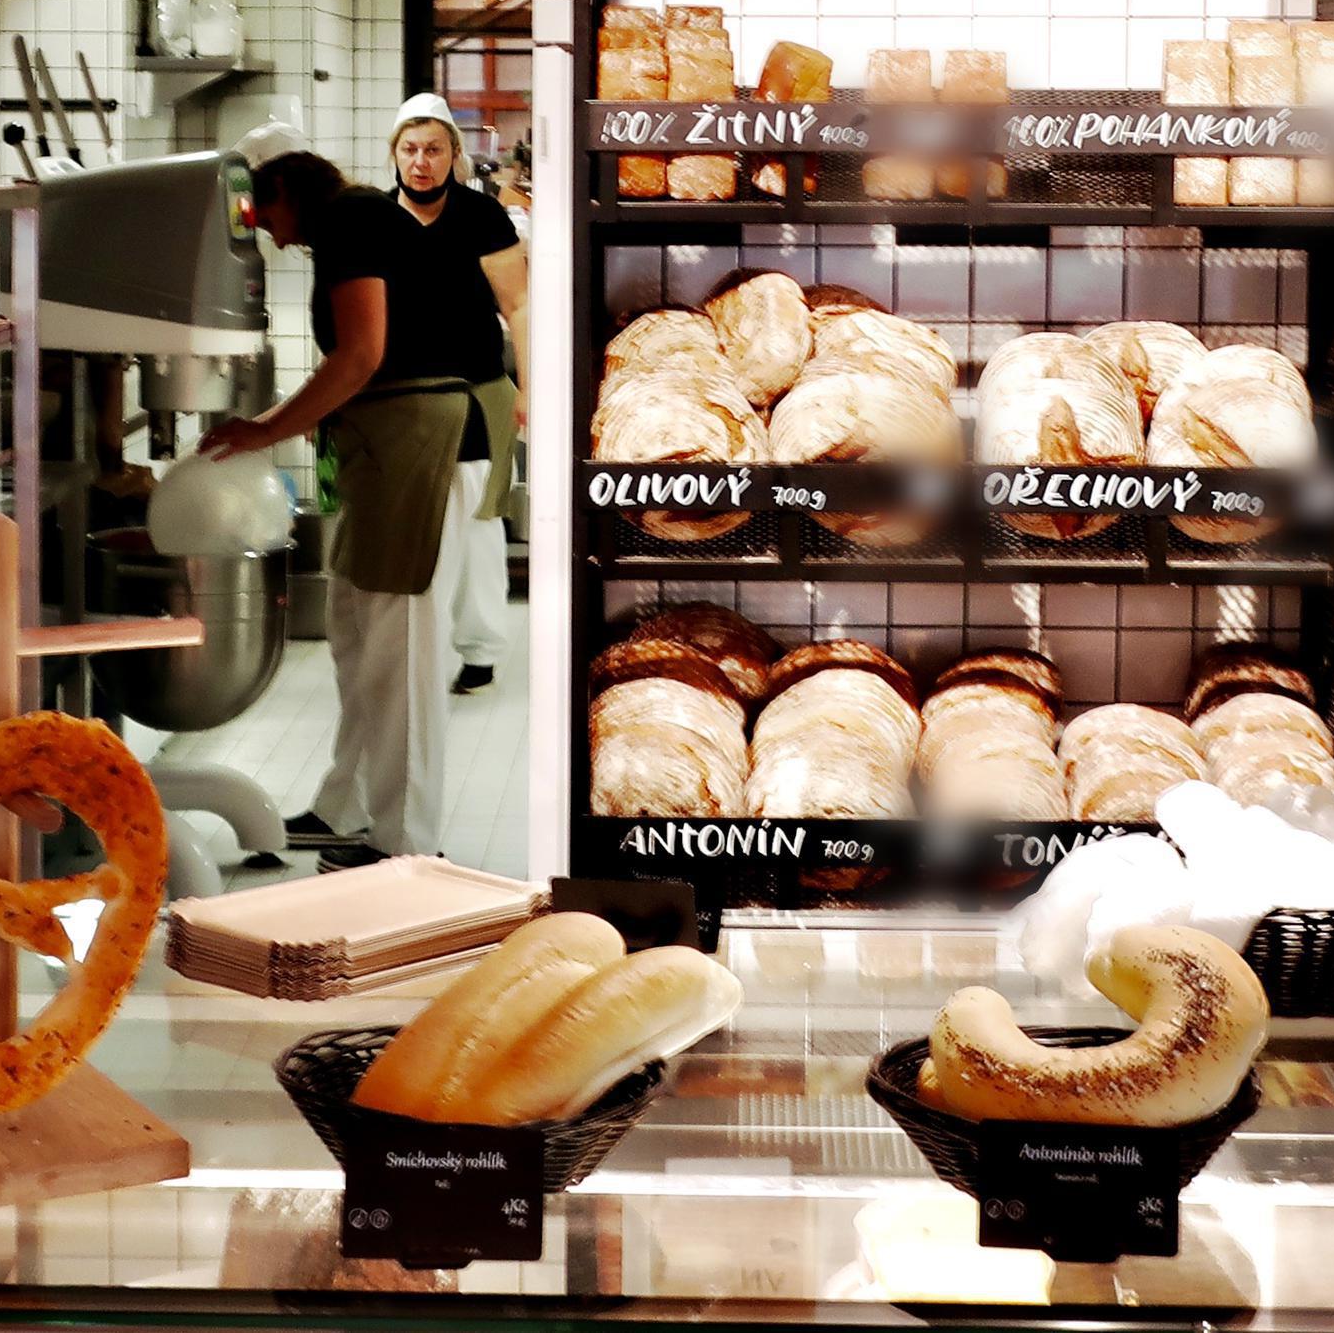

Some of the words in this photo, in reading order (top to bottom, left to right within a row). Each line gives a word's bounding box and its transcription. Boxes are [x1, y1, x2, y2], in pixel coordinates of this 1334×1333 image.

[601, 111, 676, 144] 100%
[685, 104, 818, 146] ŽITNÝ
[1074, 107, 1292, 149] POHANKOVÝ
[588, 467, 753, 507] OLIVOVÝ
[771, 485, 827, 511] 700g
[983, 467, 1203, 513] OŘECHOVÝ
[619, 819, 806, 858] ANTONÍN
[821, 839, 875, 864] 700g
[385, 1149, 463, 1174] Smíchovský
